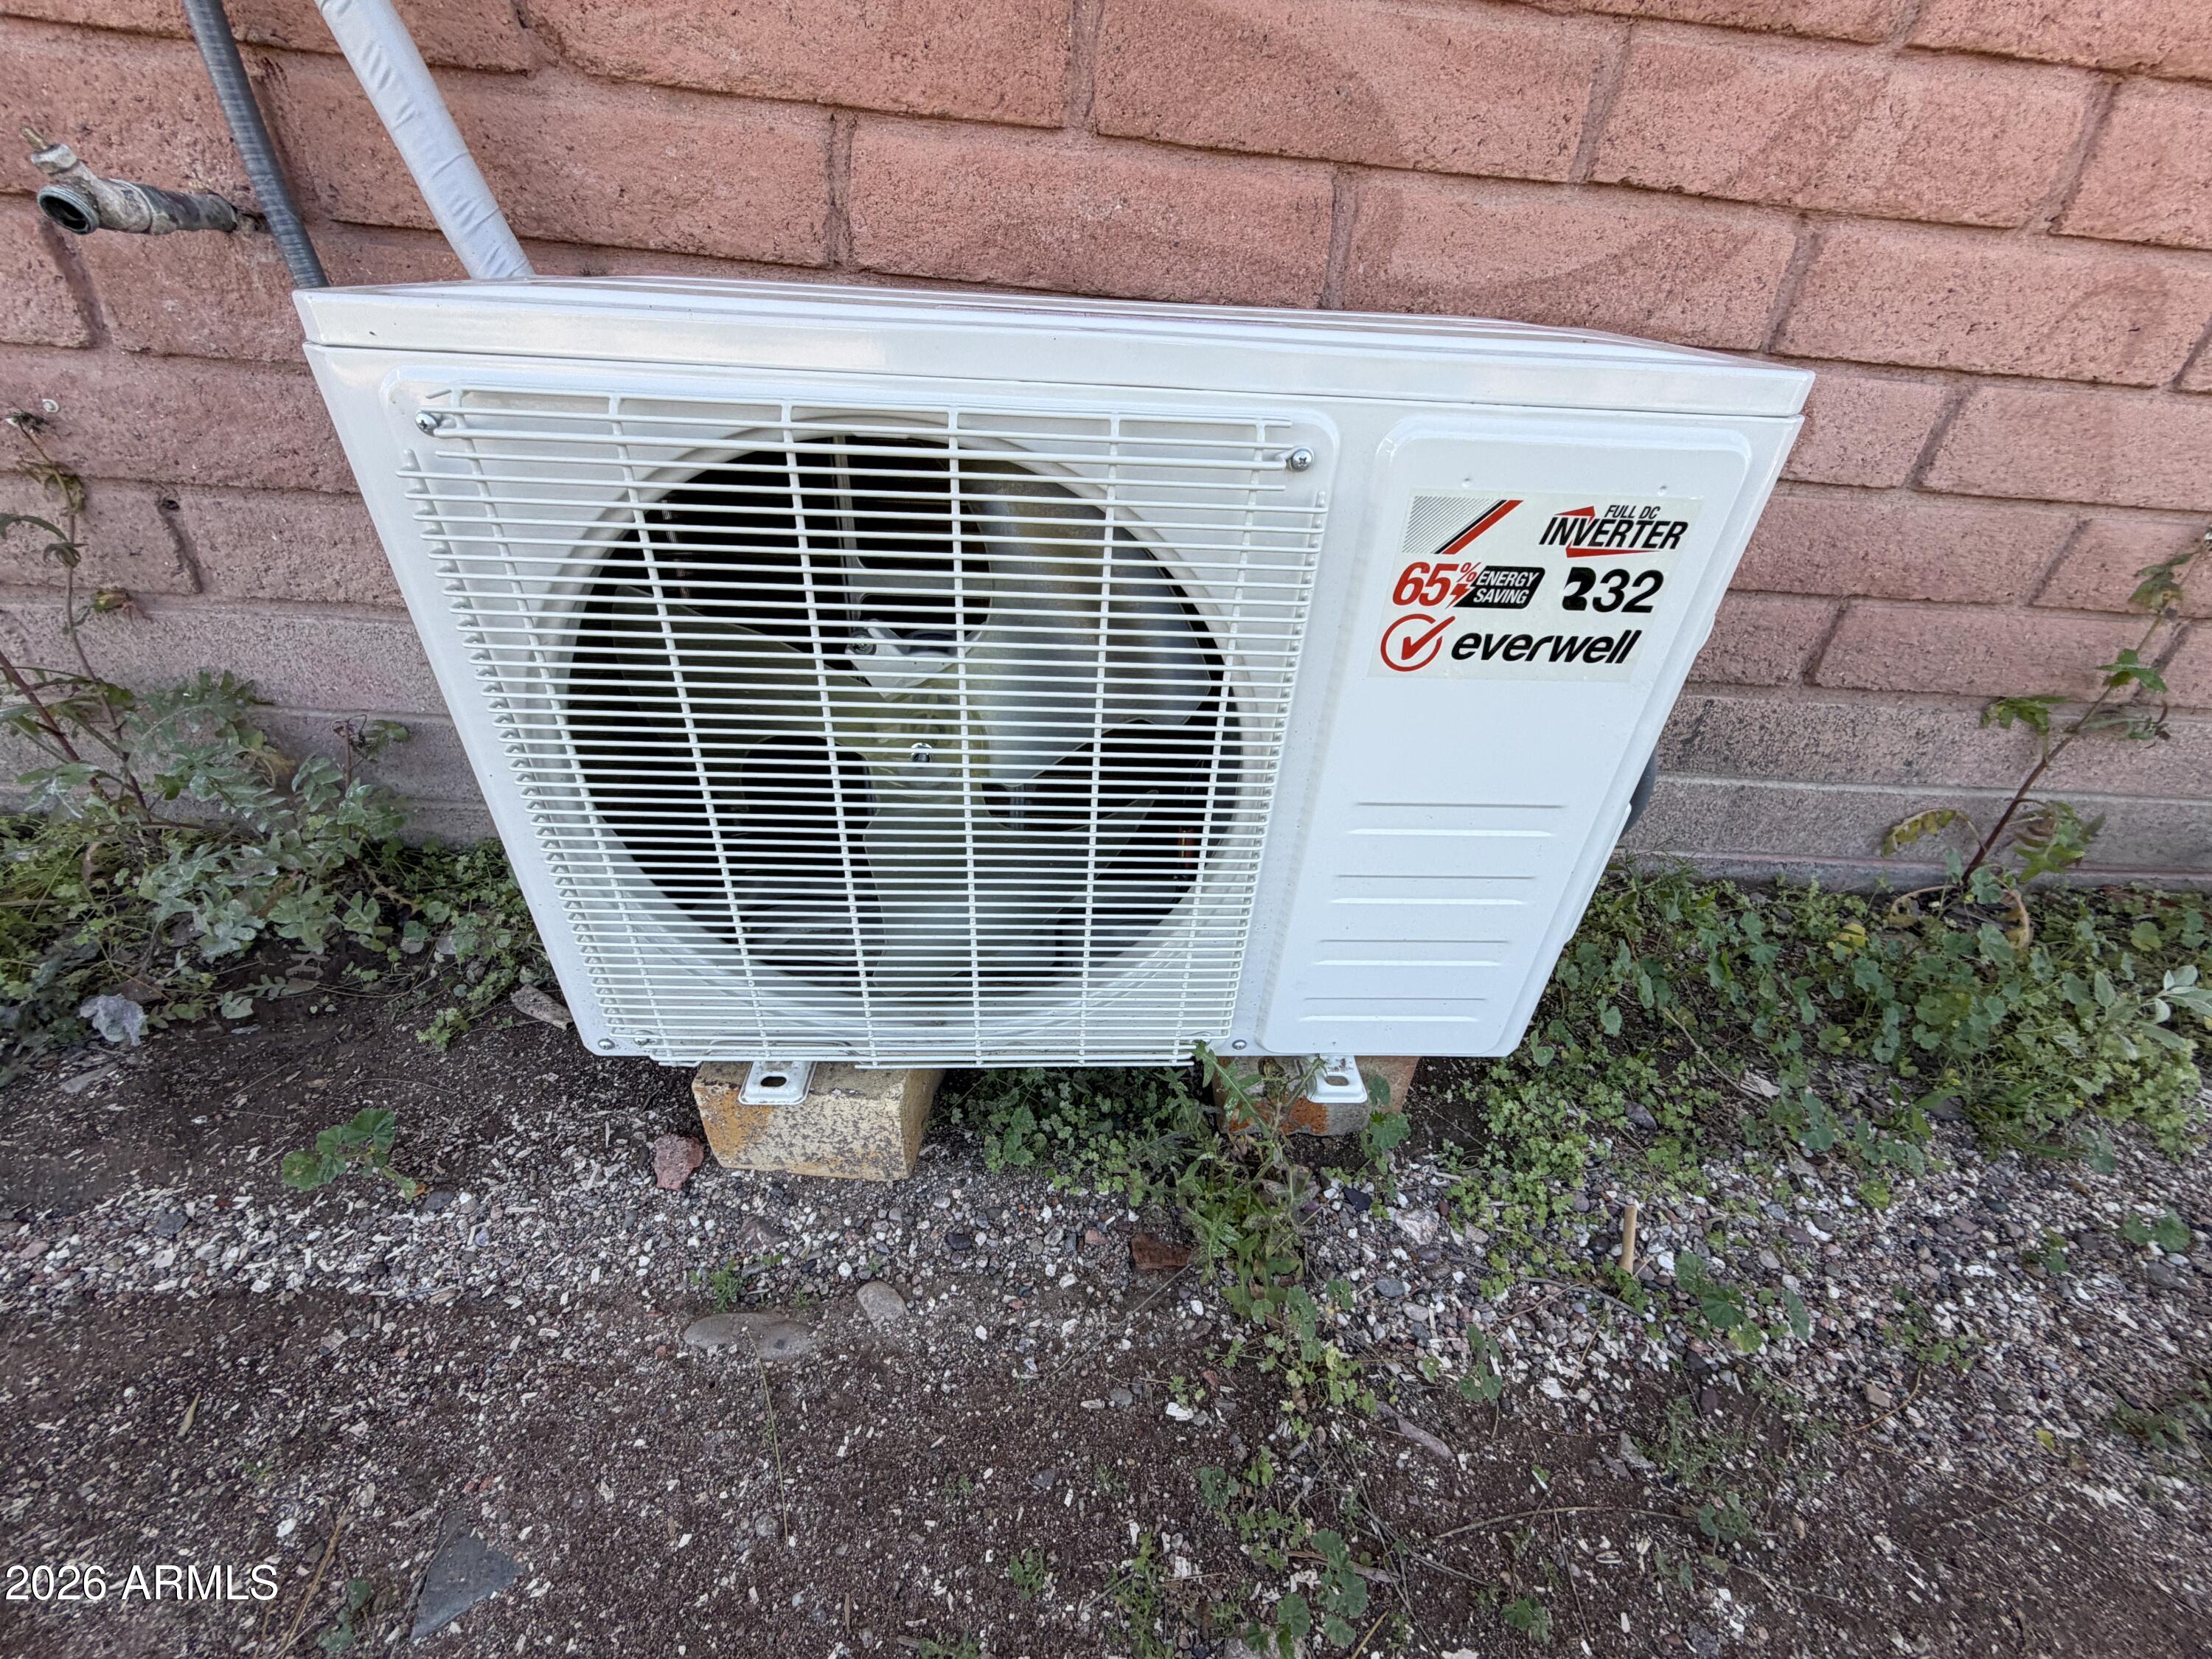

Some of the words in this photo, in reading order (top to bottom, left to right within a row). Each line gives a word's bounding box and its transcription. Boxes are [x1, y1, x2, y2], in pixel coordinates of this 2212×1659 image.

[1604, 504, 1637, 518] FULL
[1638, 505, 1661, 519] DC
[1538, 517, 1688, 549] INVERTER
[1392, 561, 1481, 607] 65%
[1476, 571, 1540, 588] ENERGY
[1473, 588, 1529, 605] SAVING
[1451, 629, 1642, 664] everwell
